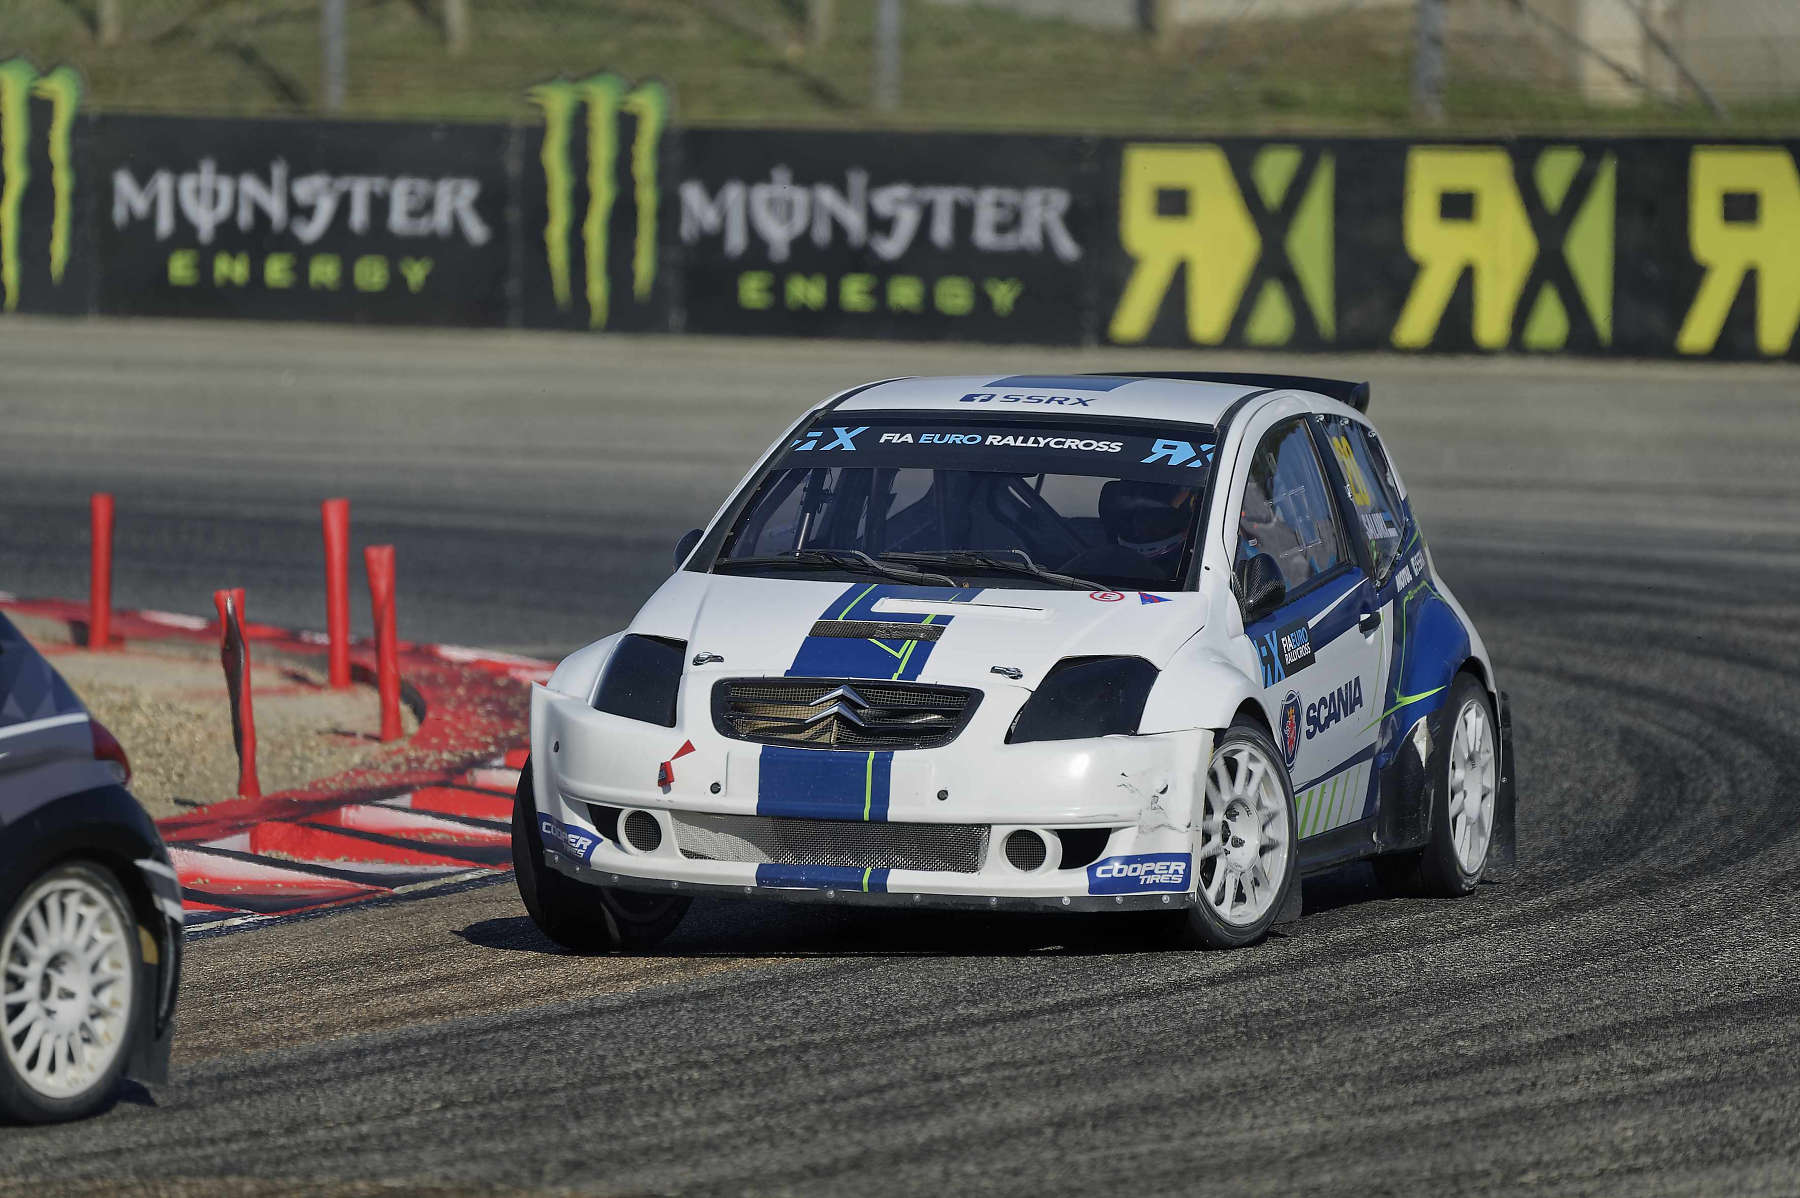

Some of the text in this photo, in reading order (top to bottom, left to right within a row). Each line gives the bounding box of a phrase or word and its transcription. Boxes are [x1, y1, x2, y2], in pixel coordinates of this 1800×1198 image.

[112, 157, 491, 246] MONSTER
[679, 163, 1082, 263] MONSTER
[167, 248, 433, 292] ENERGY
[737, 270, 1023, 316] ENERGY
[999, 394, 1096, 407] SSRX
[879, 432, 1123, 453] FIA EURO RALLYCROSS
[1305, 675, 1364, 740] SCANIA
[1096, 862, 1186, 878] COOPER
[1139, 874, 1183, 885] TIRES
